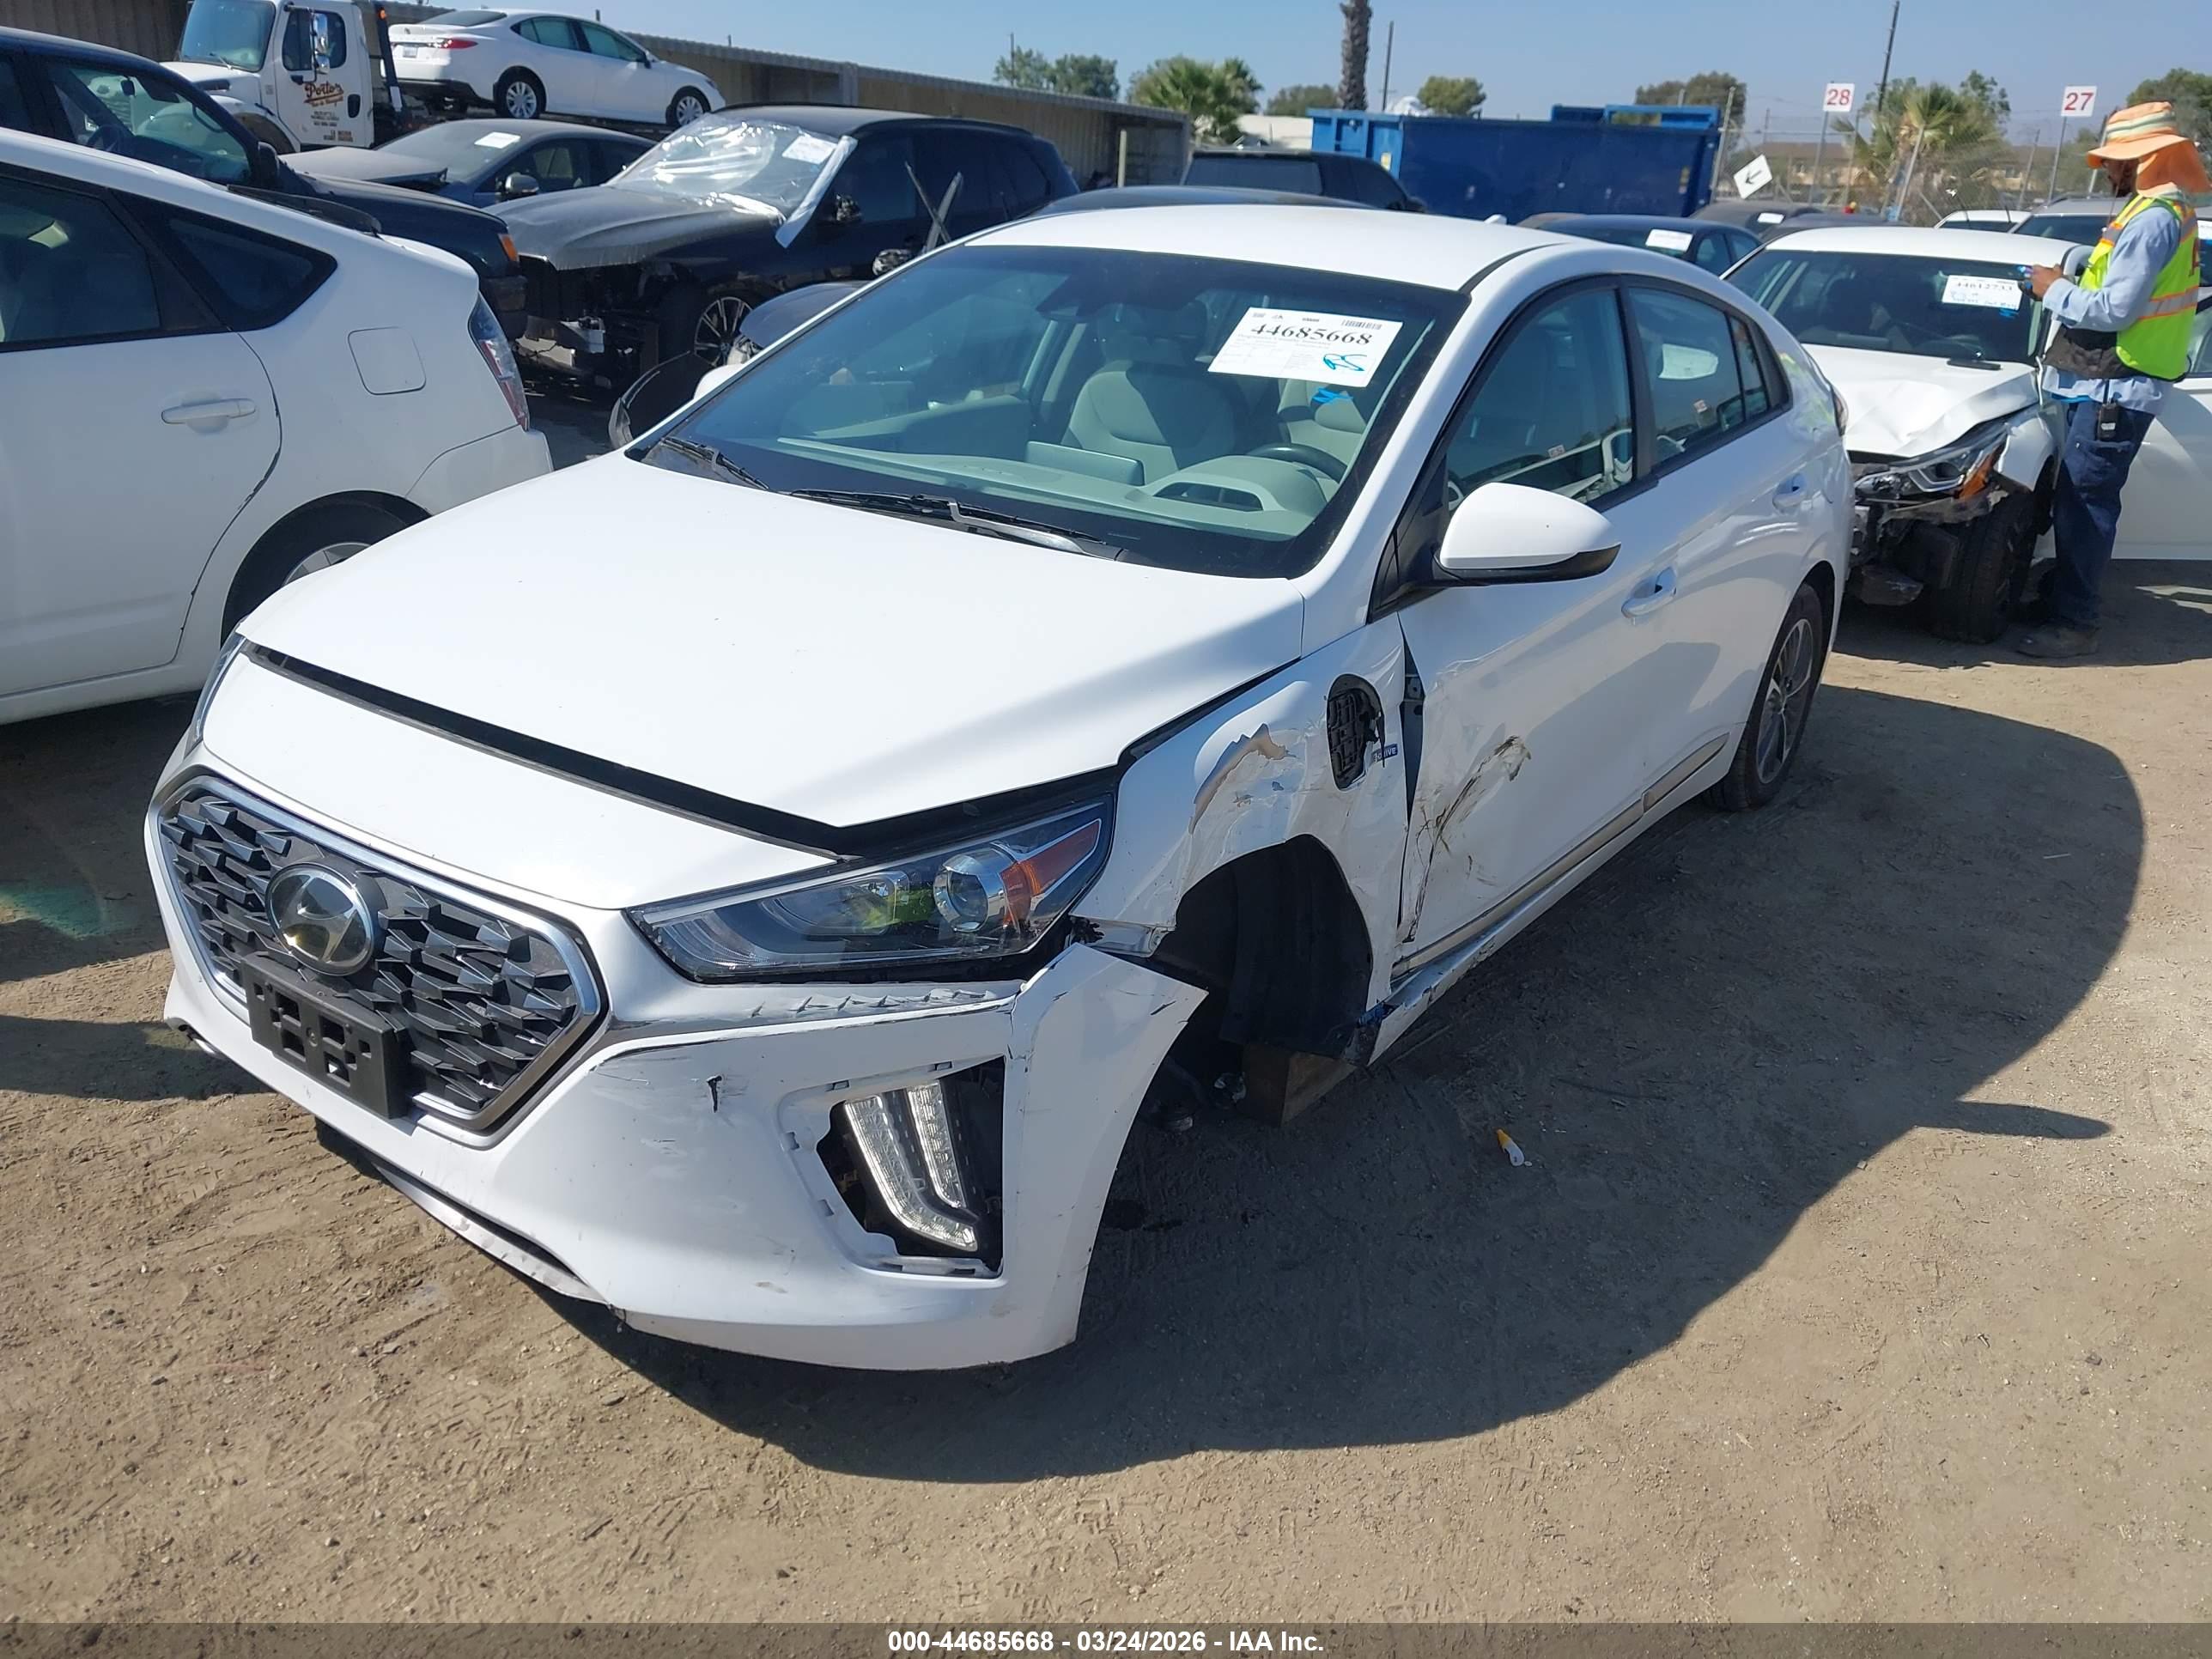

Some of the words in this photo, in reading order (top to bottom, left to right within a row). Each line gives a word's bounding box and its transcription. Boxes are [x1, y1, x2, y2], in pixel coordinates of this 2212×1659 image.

[1827, 88, 1850, 106] 28
[2064, 92, 2094, 111] 27
[1250, 323, 1373, 345] 44685668
